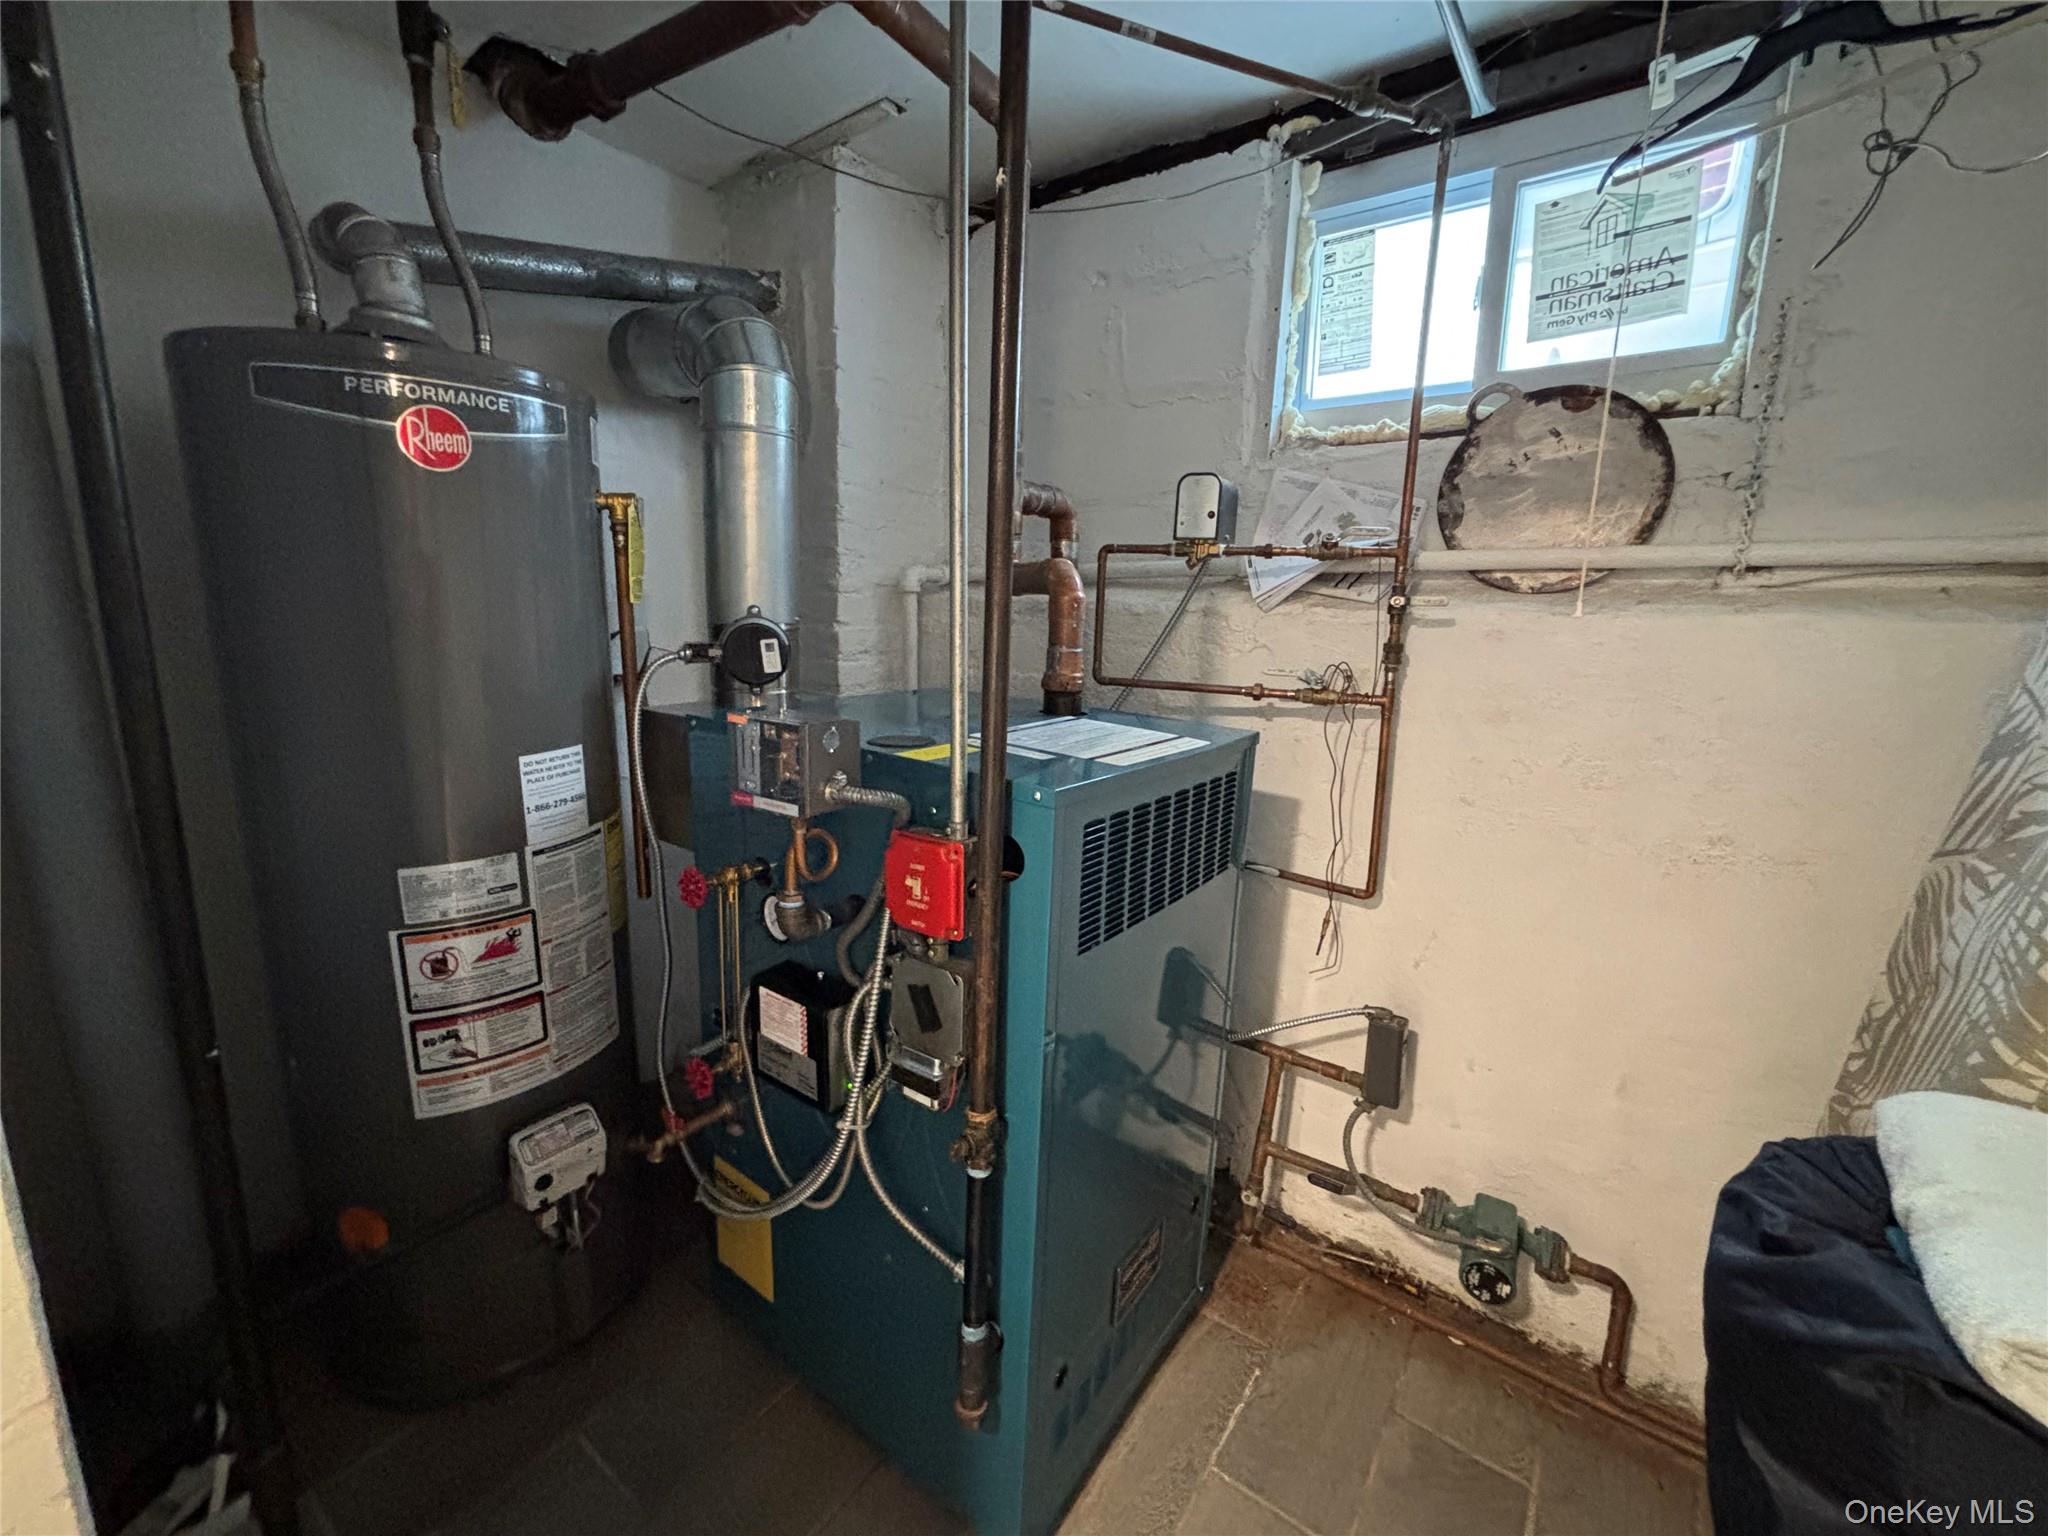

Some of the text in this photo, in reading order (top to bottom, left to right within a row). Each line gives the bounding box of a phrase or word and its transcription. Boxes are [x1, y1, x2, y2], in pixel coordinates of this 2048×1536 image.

[344, 376, 511, 413] PERFORMANCE
[405, 407, 468, 460] Rheem
[535, 758, 547, 766] NOT
